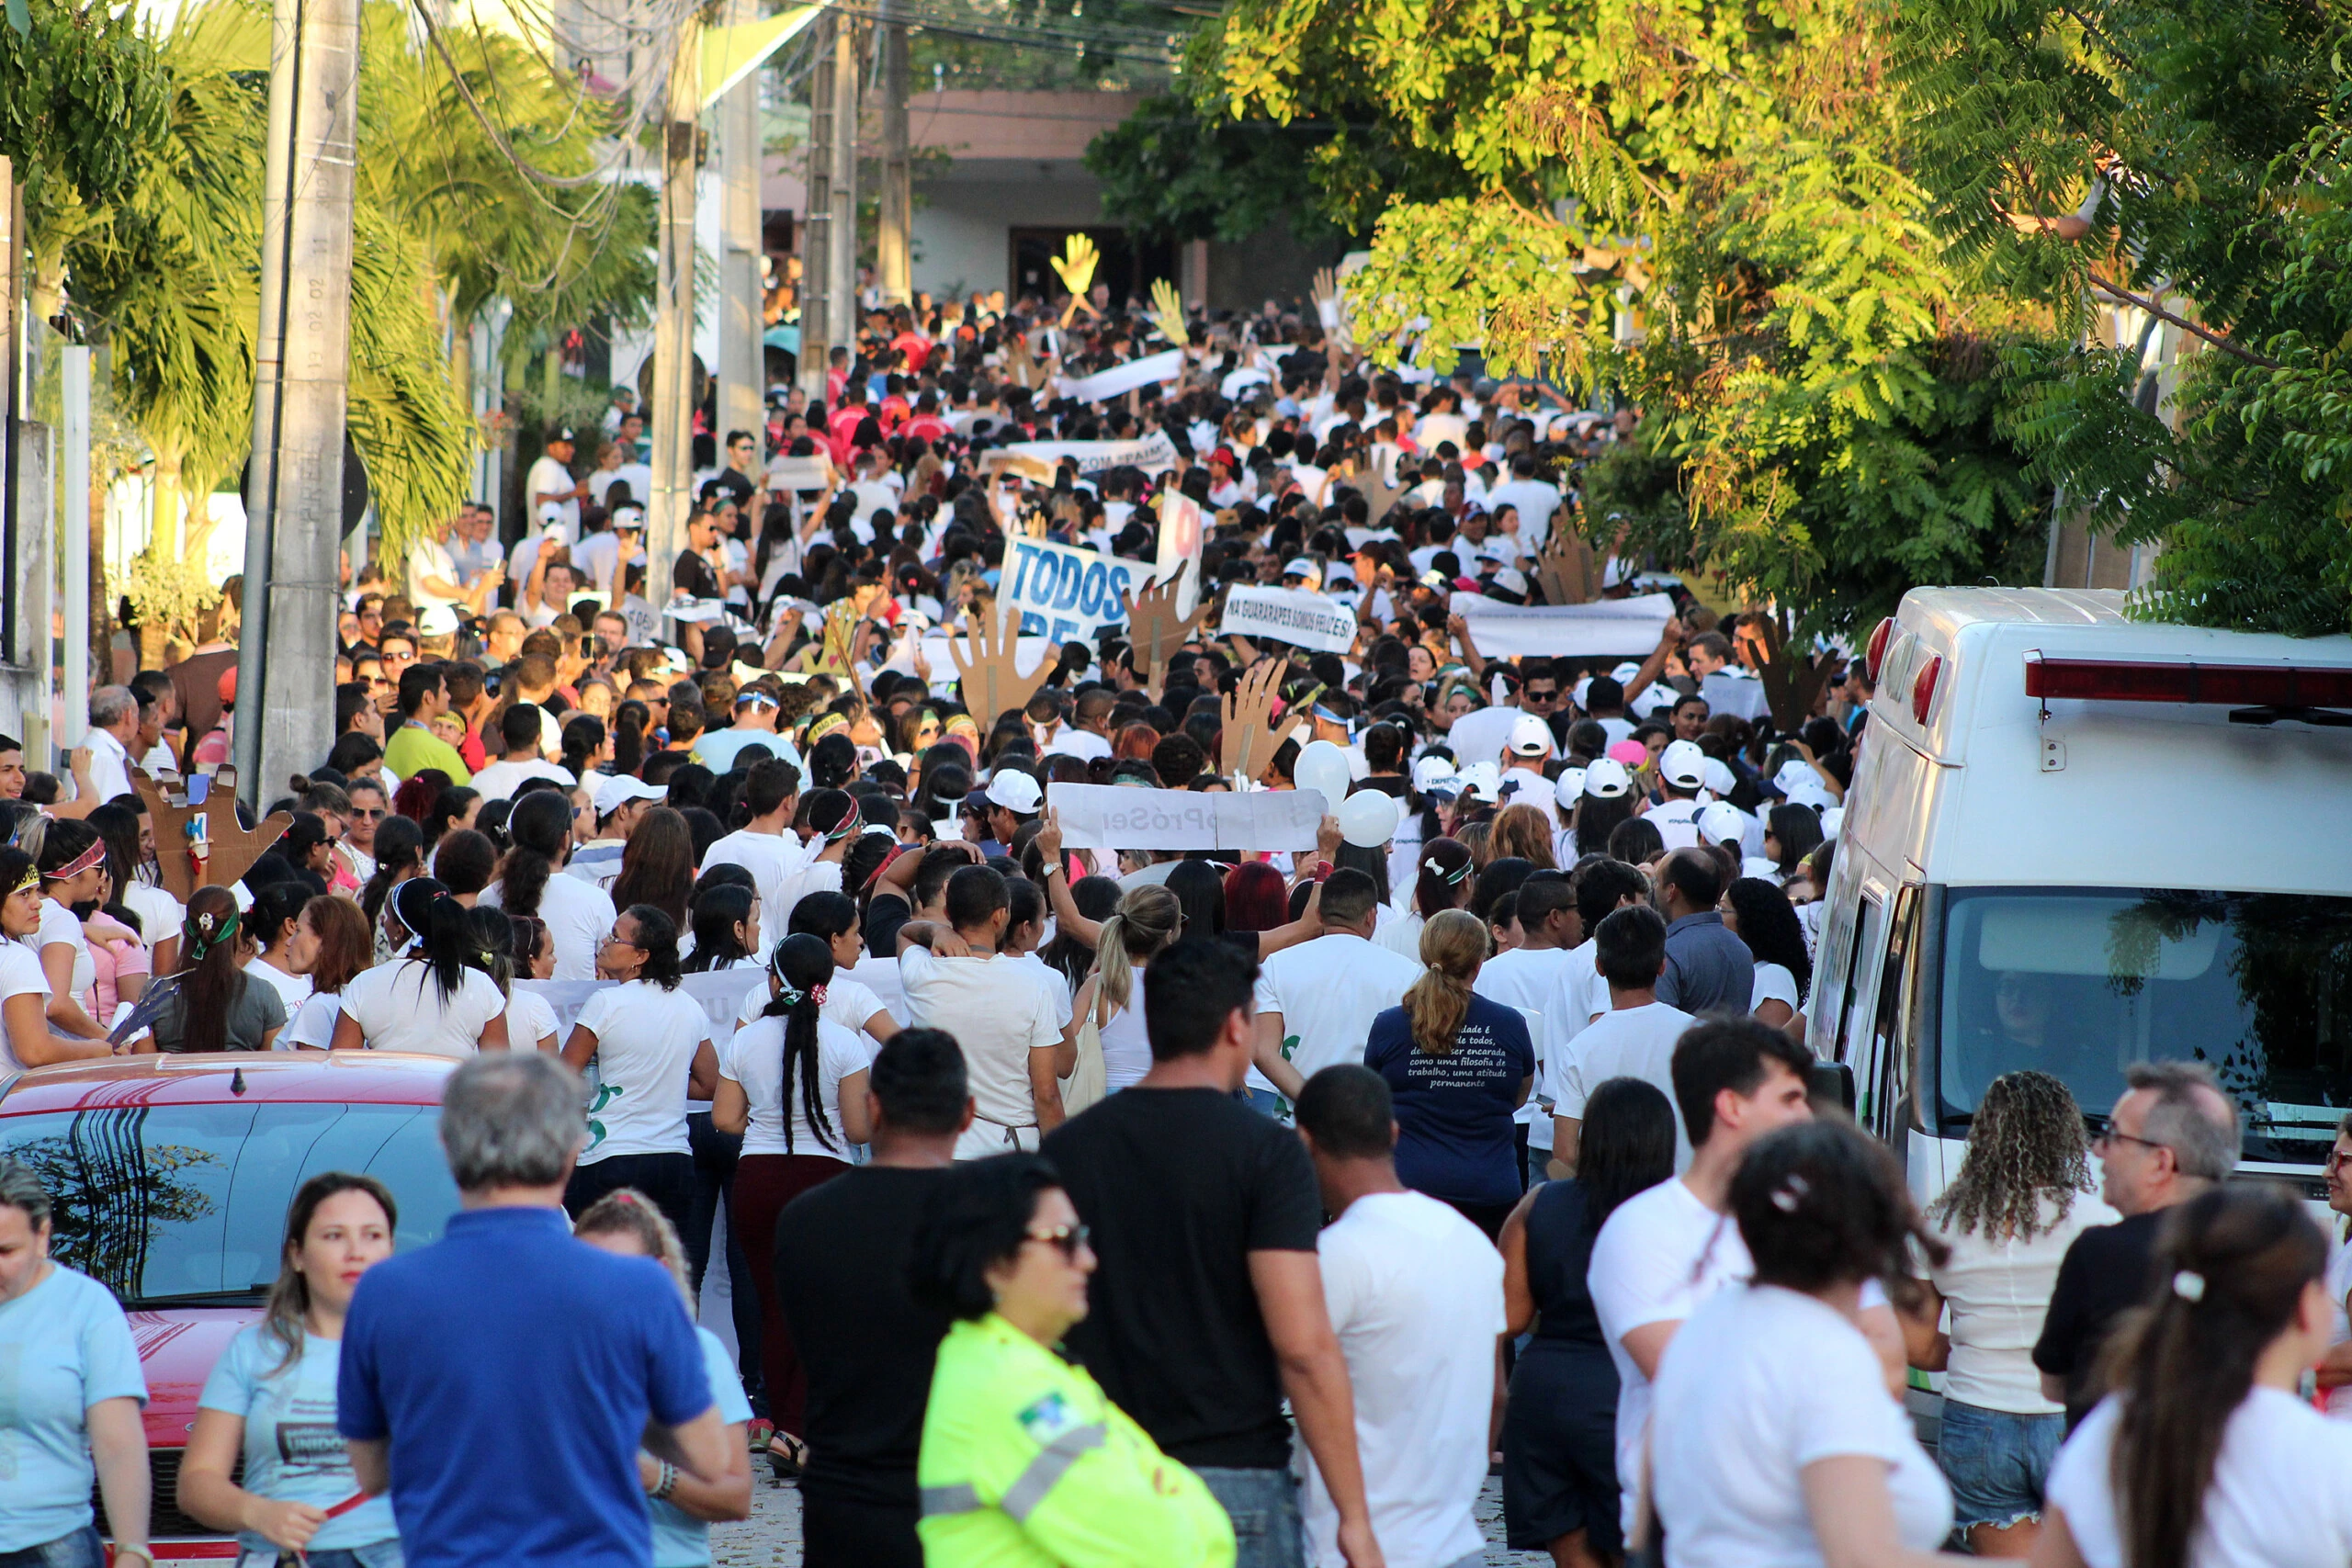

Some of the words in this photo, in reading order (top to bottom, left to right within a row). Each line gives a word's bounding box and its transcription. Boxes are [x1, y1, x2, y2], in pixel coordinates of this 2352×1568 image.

[309, 278, 323, 299] 02
[1012, 542, 1131, 621] TODOS
[1227, 599, 1240, 616] NA
[1241, 600, 1292, 626] GUARARAPES
[1292, 610, 1316, 631] SOMOS
[1315, 613, 1352, 638] FELIZES!
[1469, 1036, 1496, 1046] todos,
[1467, 1047, 1506, 1056] encarada
[1409, 1058, 1434, 1066] como
[1437, 1058, 1457, 1066] uma
[1460, 1056, 1494, 1067] filosofia
[1496, 1058, 1506, 1067] de
[1408, 1066, 1450, 1077] trabalho,
[1453, 1068, 1473, 1077] uma
[1476, 1068, 1507, 1077] atitude
[1430, 1078, 1486, 1089] permanente
